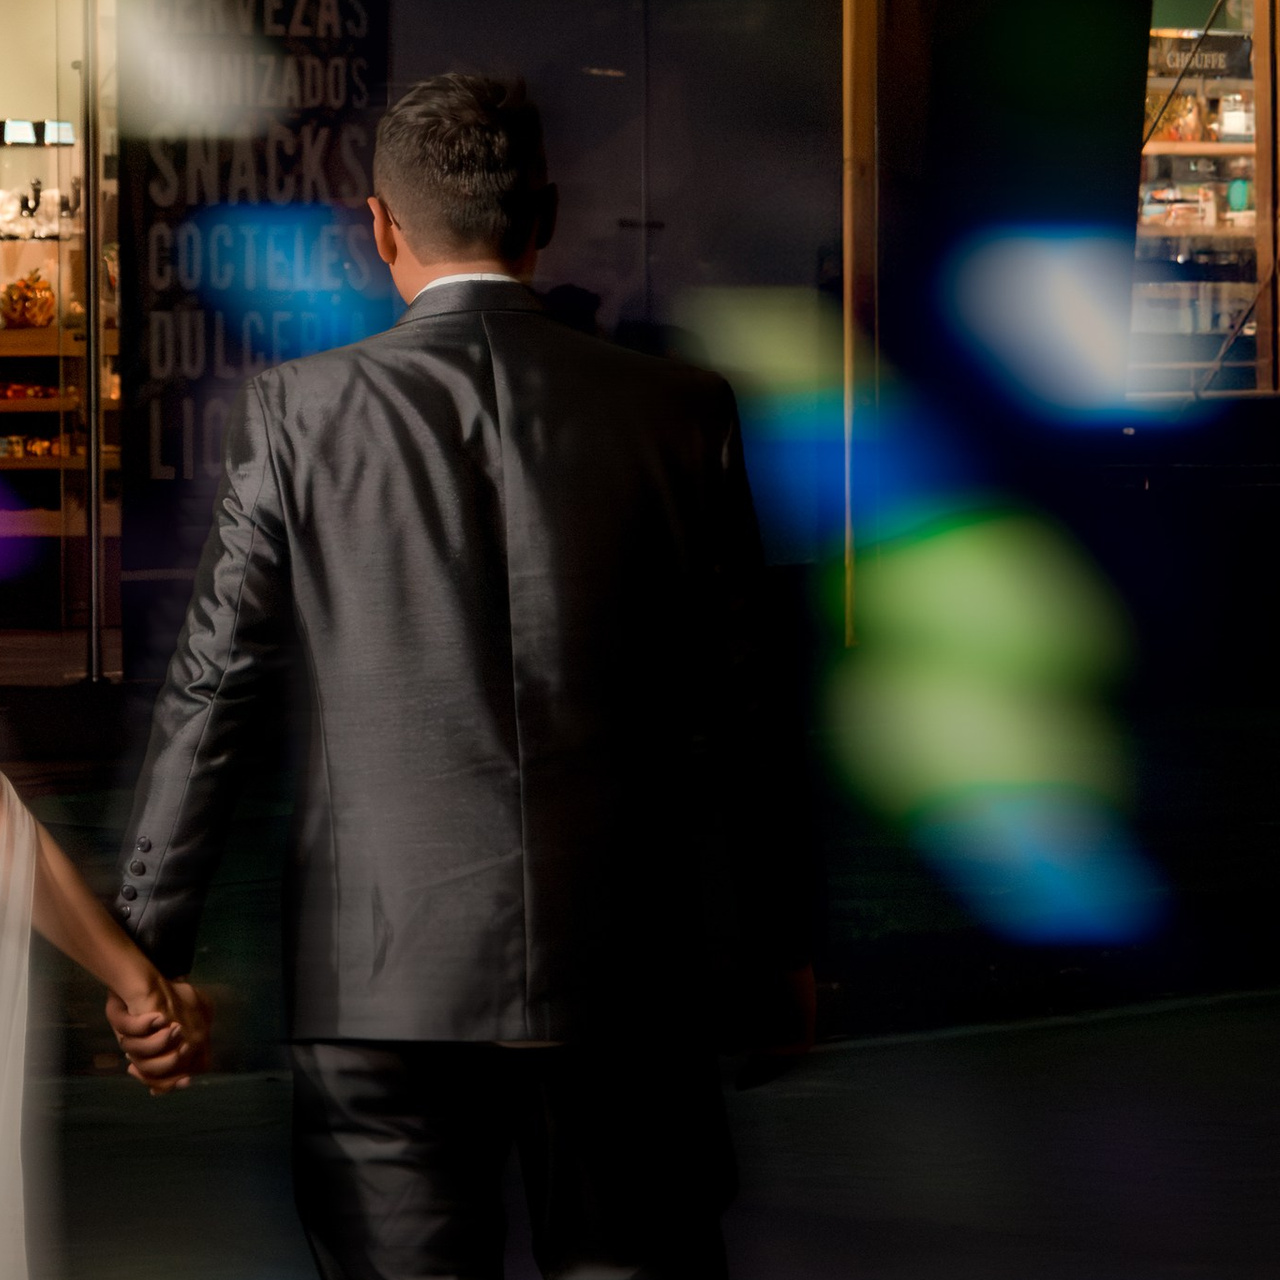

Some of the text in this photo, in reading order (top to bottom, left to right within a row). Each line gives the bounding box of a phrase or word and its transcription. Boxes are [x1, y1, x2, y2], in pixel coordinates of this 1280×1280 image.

[148, 52, 370, 110] NIZADOS
[148, 122, 370, 209] SNACKS
[148, 221, 371, 292] COCTELES
